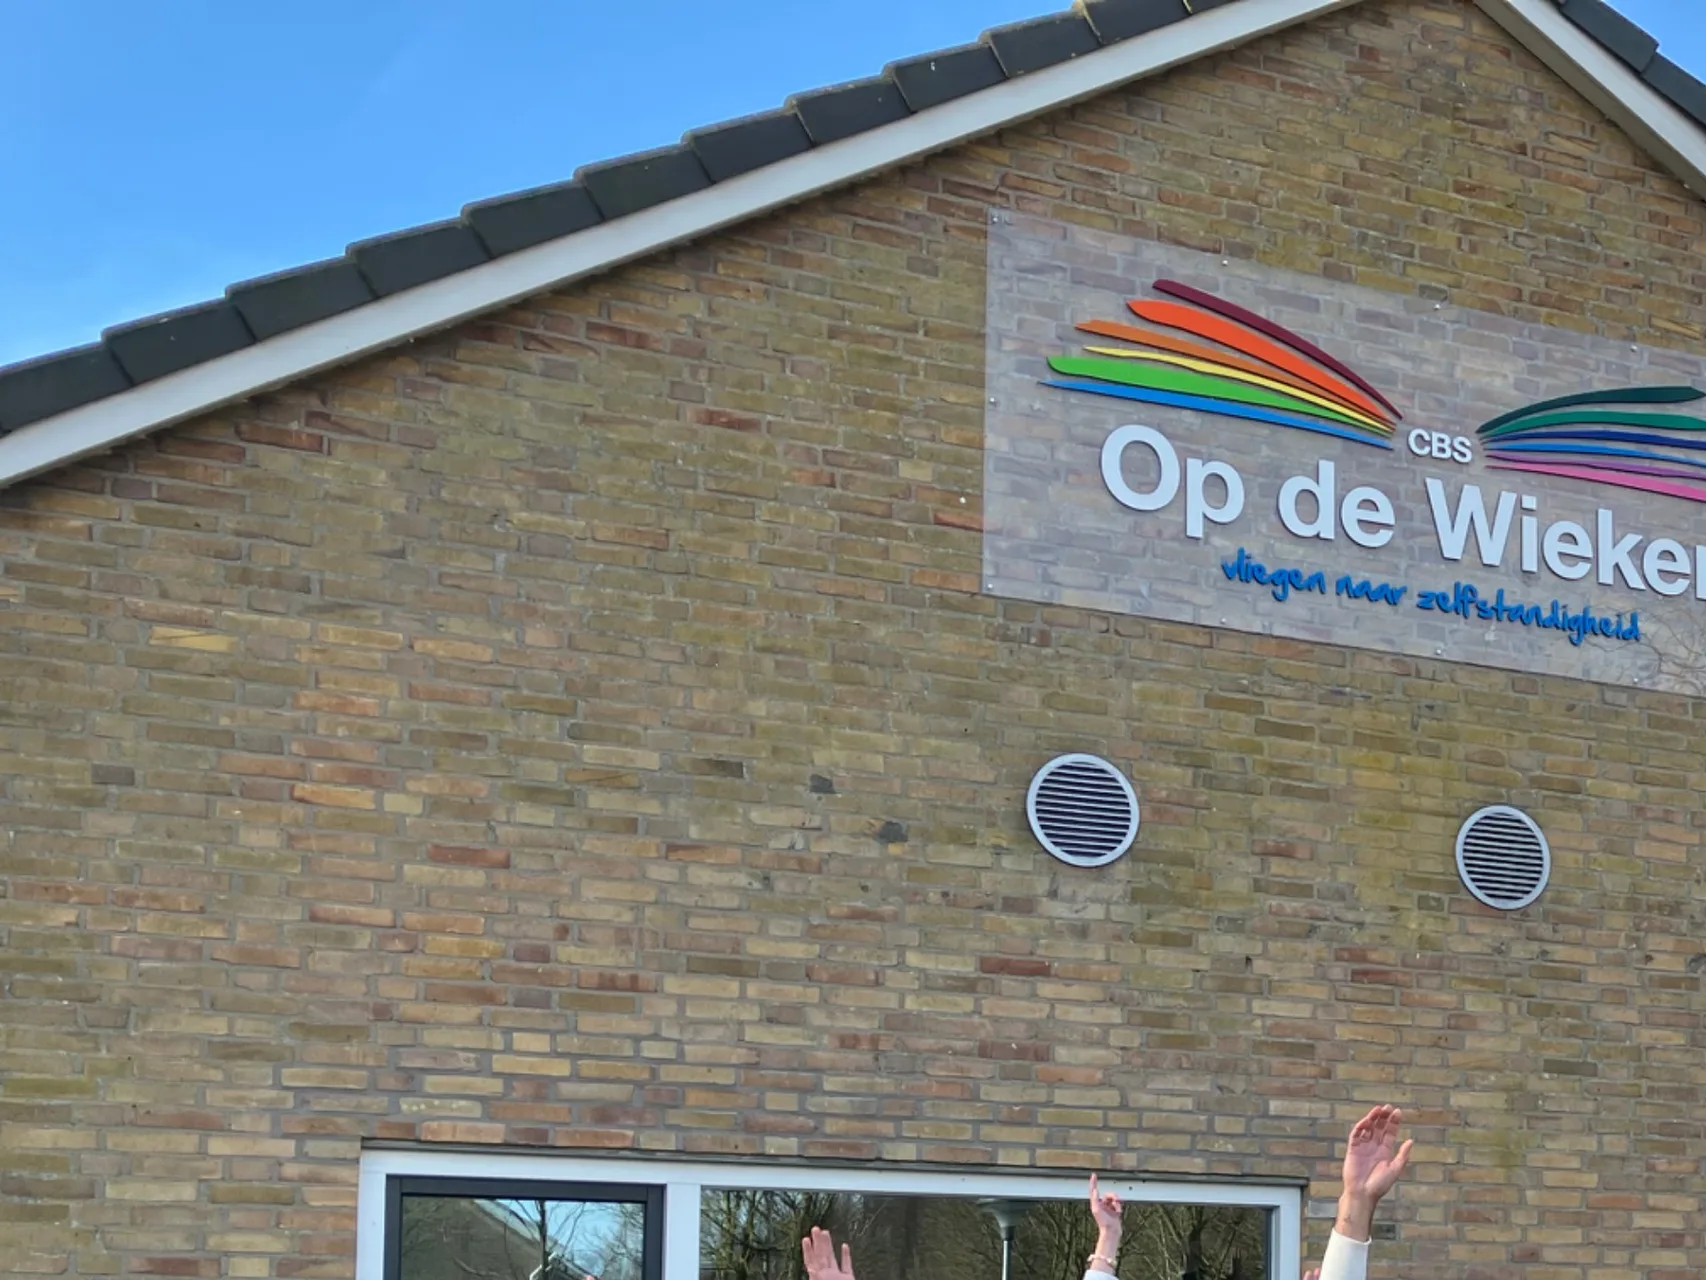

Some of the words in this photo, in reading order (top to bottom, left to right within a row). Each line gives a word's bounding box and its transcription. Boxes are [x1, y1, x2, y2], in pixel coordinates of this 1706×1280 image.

[1100, 424, 1245, 540] Op
[1278, 460, 1395, 548] de
[1408, 428, 1473, 464] CBS
[1221, 547, 1326, 602] vliegen
[1336, 575, 1407, 606] naar
[1416, 581, 1641, 646] zelfstandigheid
